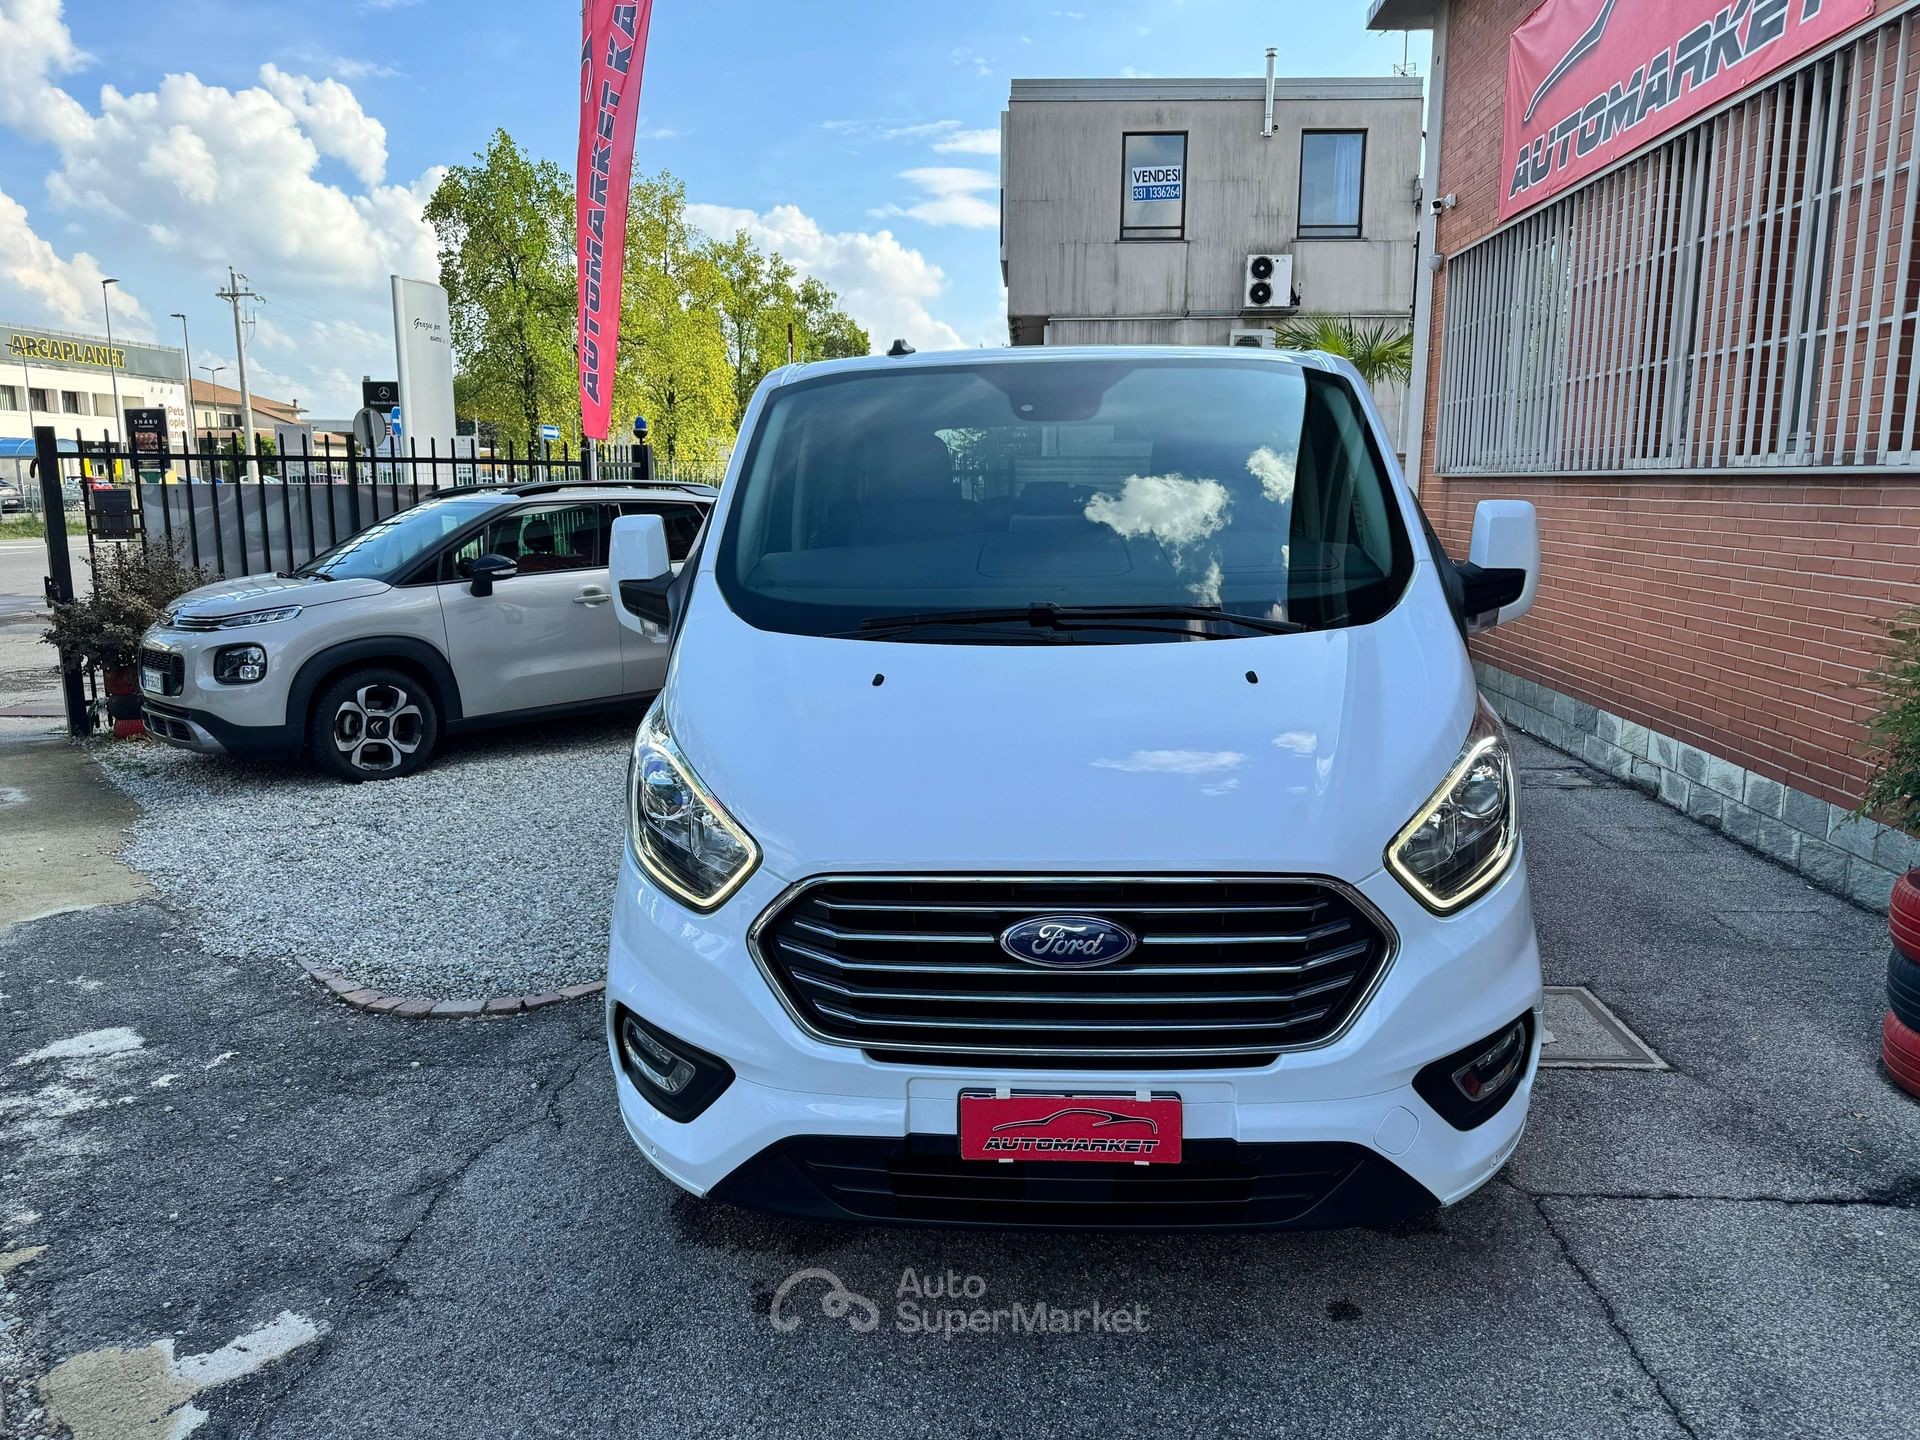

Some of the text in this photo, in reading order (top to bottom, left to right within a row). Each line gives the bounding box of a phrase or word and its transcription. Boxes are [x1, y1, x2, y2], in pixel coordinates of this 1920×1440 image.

[1133, 168, 1181, 183] VENDESI
[1133, 186, 1180, 199] 331 1336264
[581, 0, 640, 405] AUTOMARKET KA
[413, 317, 433, 331] Grazie
[10, 334, 126, 368] ARCAPLANET
[1031, 924, 1104, 955] Ford
[983, 1136, 1160, 1153] AUTOMARKET
